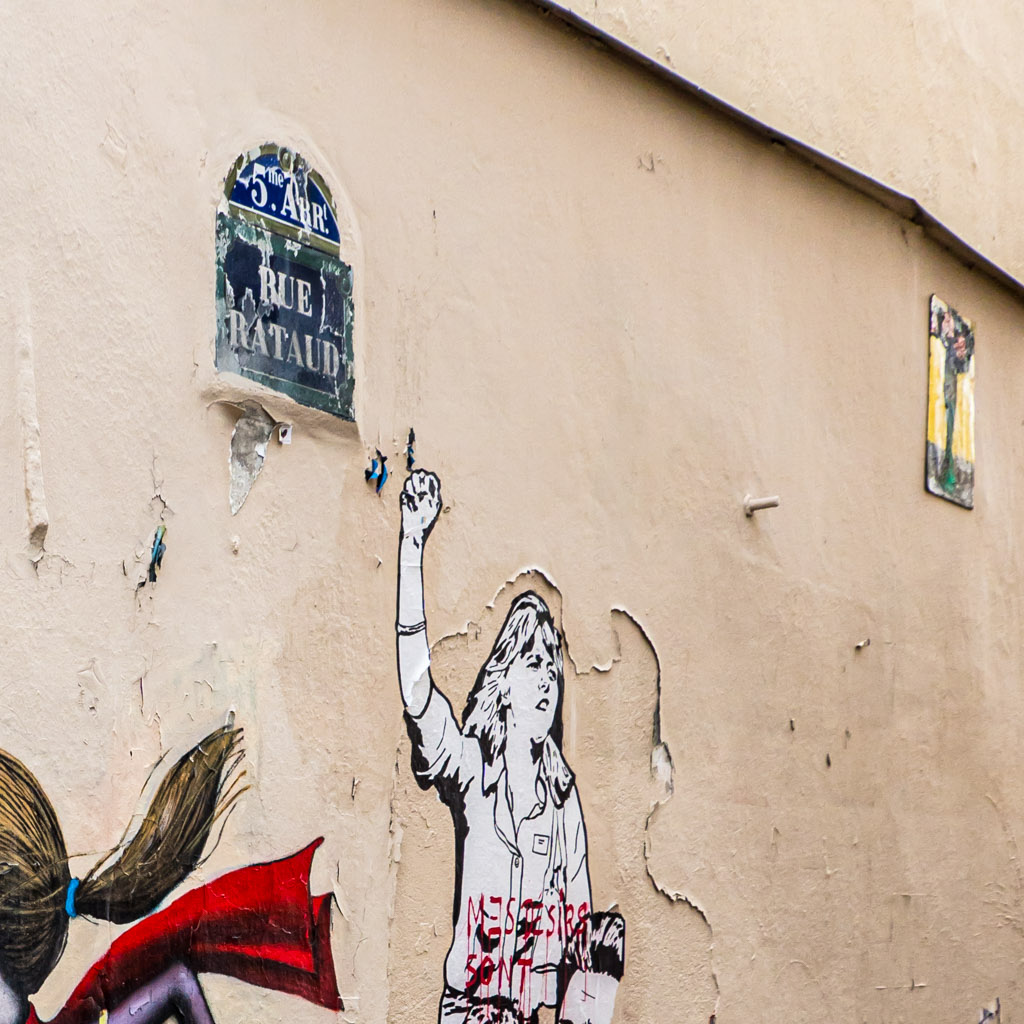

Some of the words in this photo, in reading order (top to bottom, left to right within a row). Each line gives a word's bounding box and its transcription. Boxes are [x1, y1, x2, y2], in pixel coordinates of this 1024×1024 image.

[259, 264, 312, 317] RUE
[230, 309, 340, 377] RATAUD
[465, 954, 533, 994] SONT
